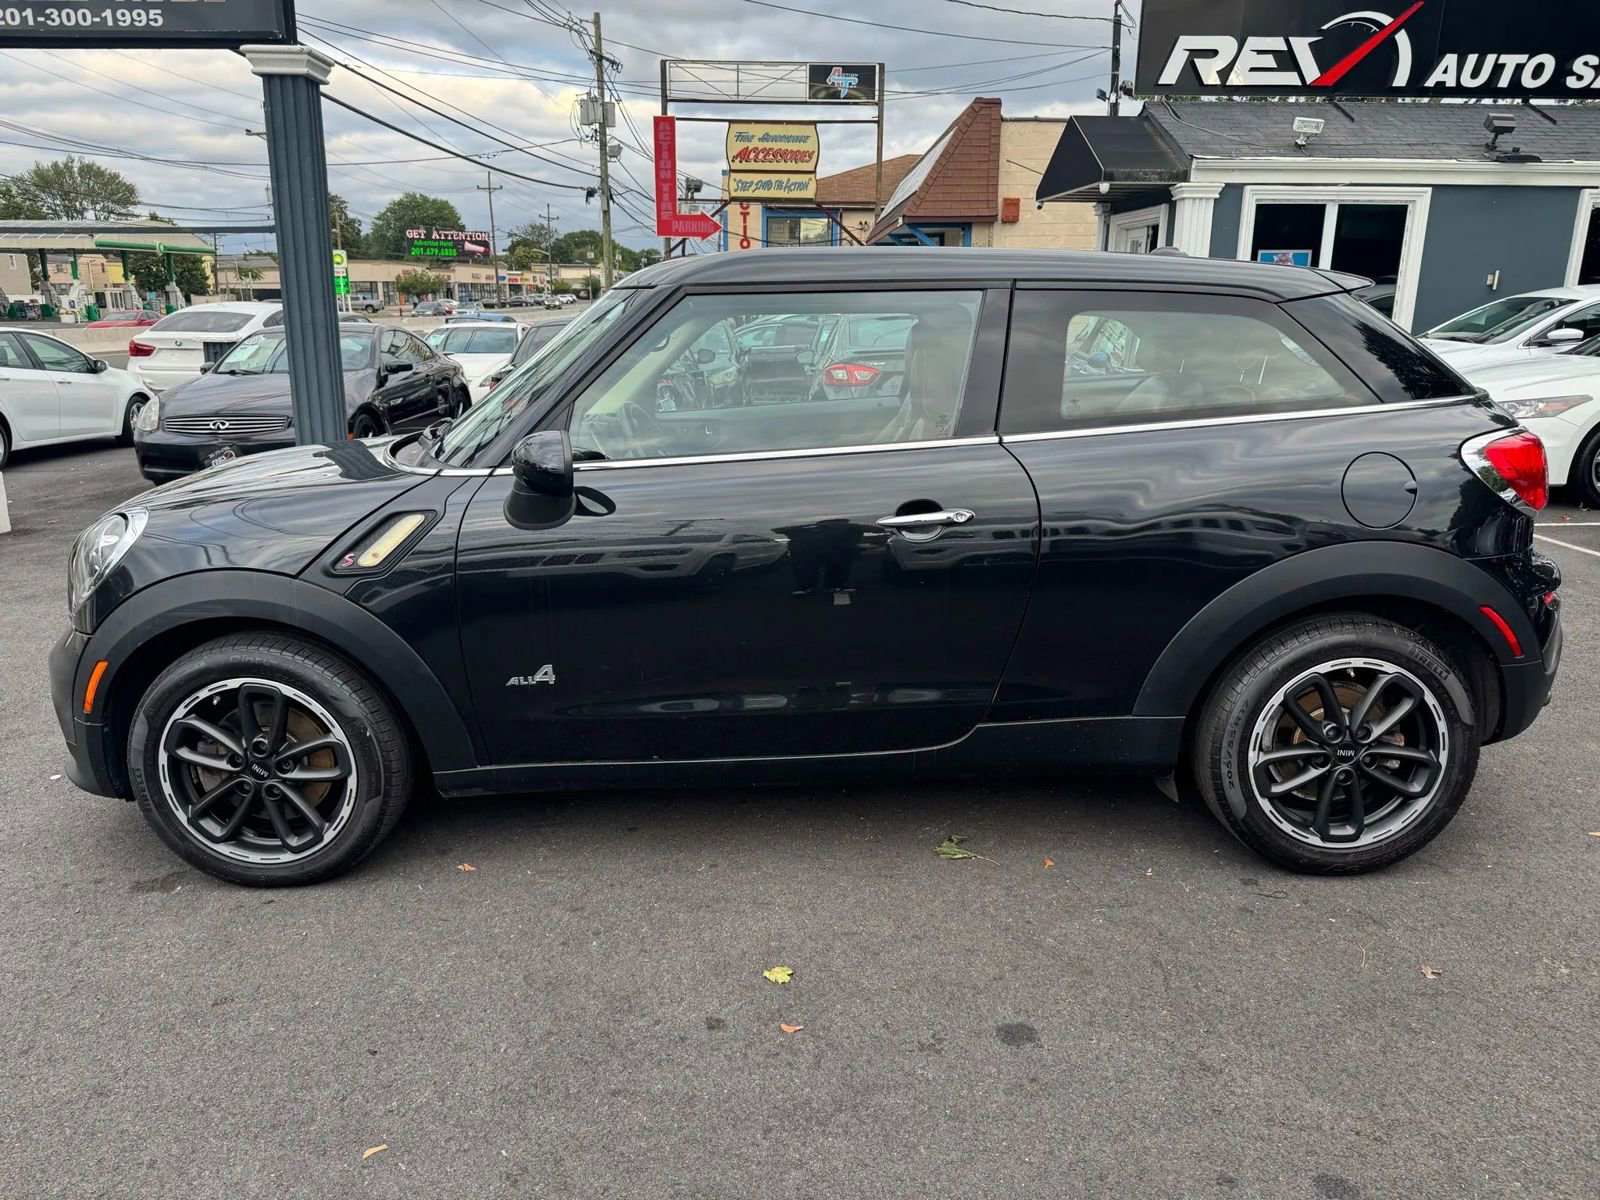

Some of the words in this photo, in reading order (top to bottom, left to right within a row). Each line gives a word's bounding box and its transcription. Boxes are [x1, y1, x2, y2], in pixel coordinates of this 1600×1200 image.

[1423, 53, 1556, 88] AUTO
[1565, 54, 1600, 89] S
[658, 121, 673, 179] ACTION
[731, 145, 816, 164] ACCESSORIES
[660, 183, 673, 220] TIRE
[671, 220, 715, 233] PARKING
[406, 229, 426, 239] GET
[431, 230, 488, 241] ATTENTION
[341, 553, 355, 567] S
[1336, 749, 1355, 757] MINI
[251, 763, 269, 778] MINI
